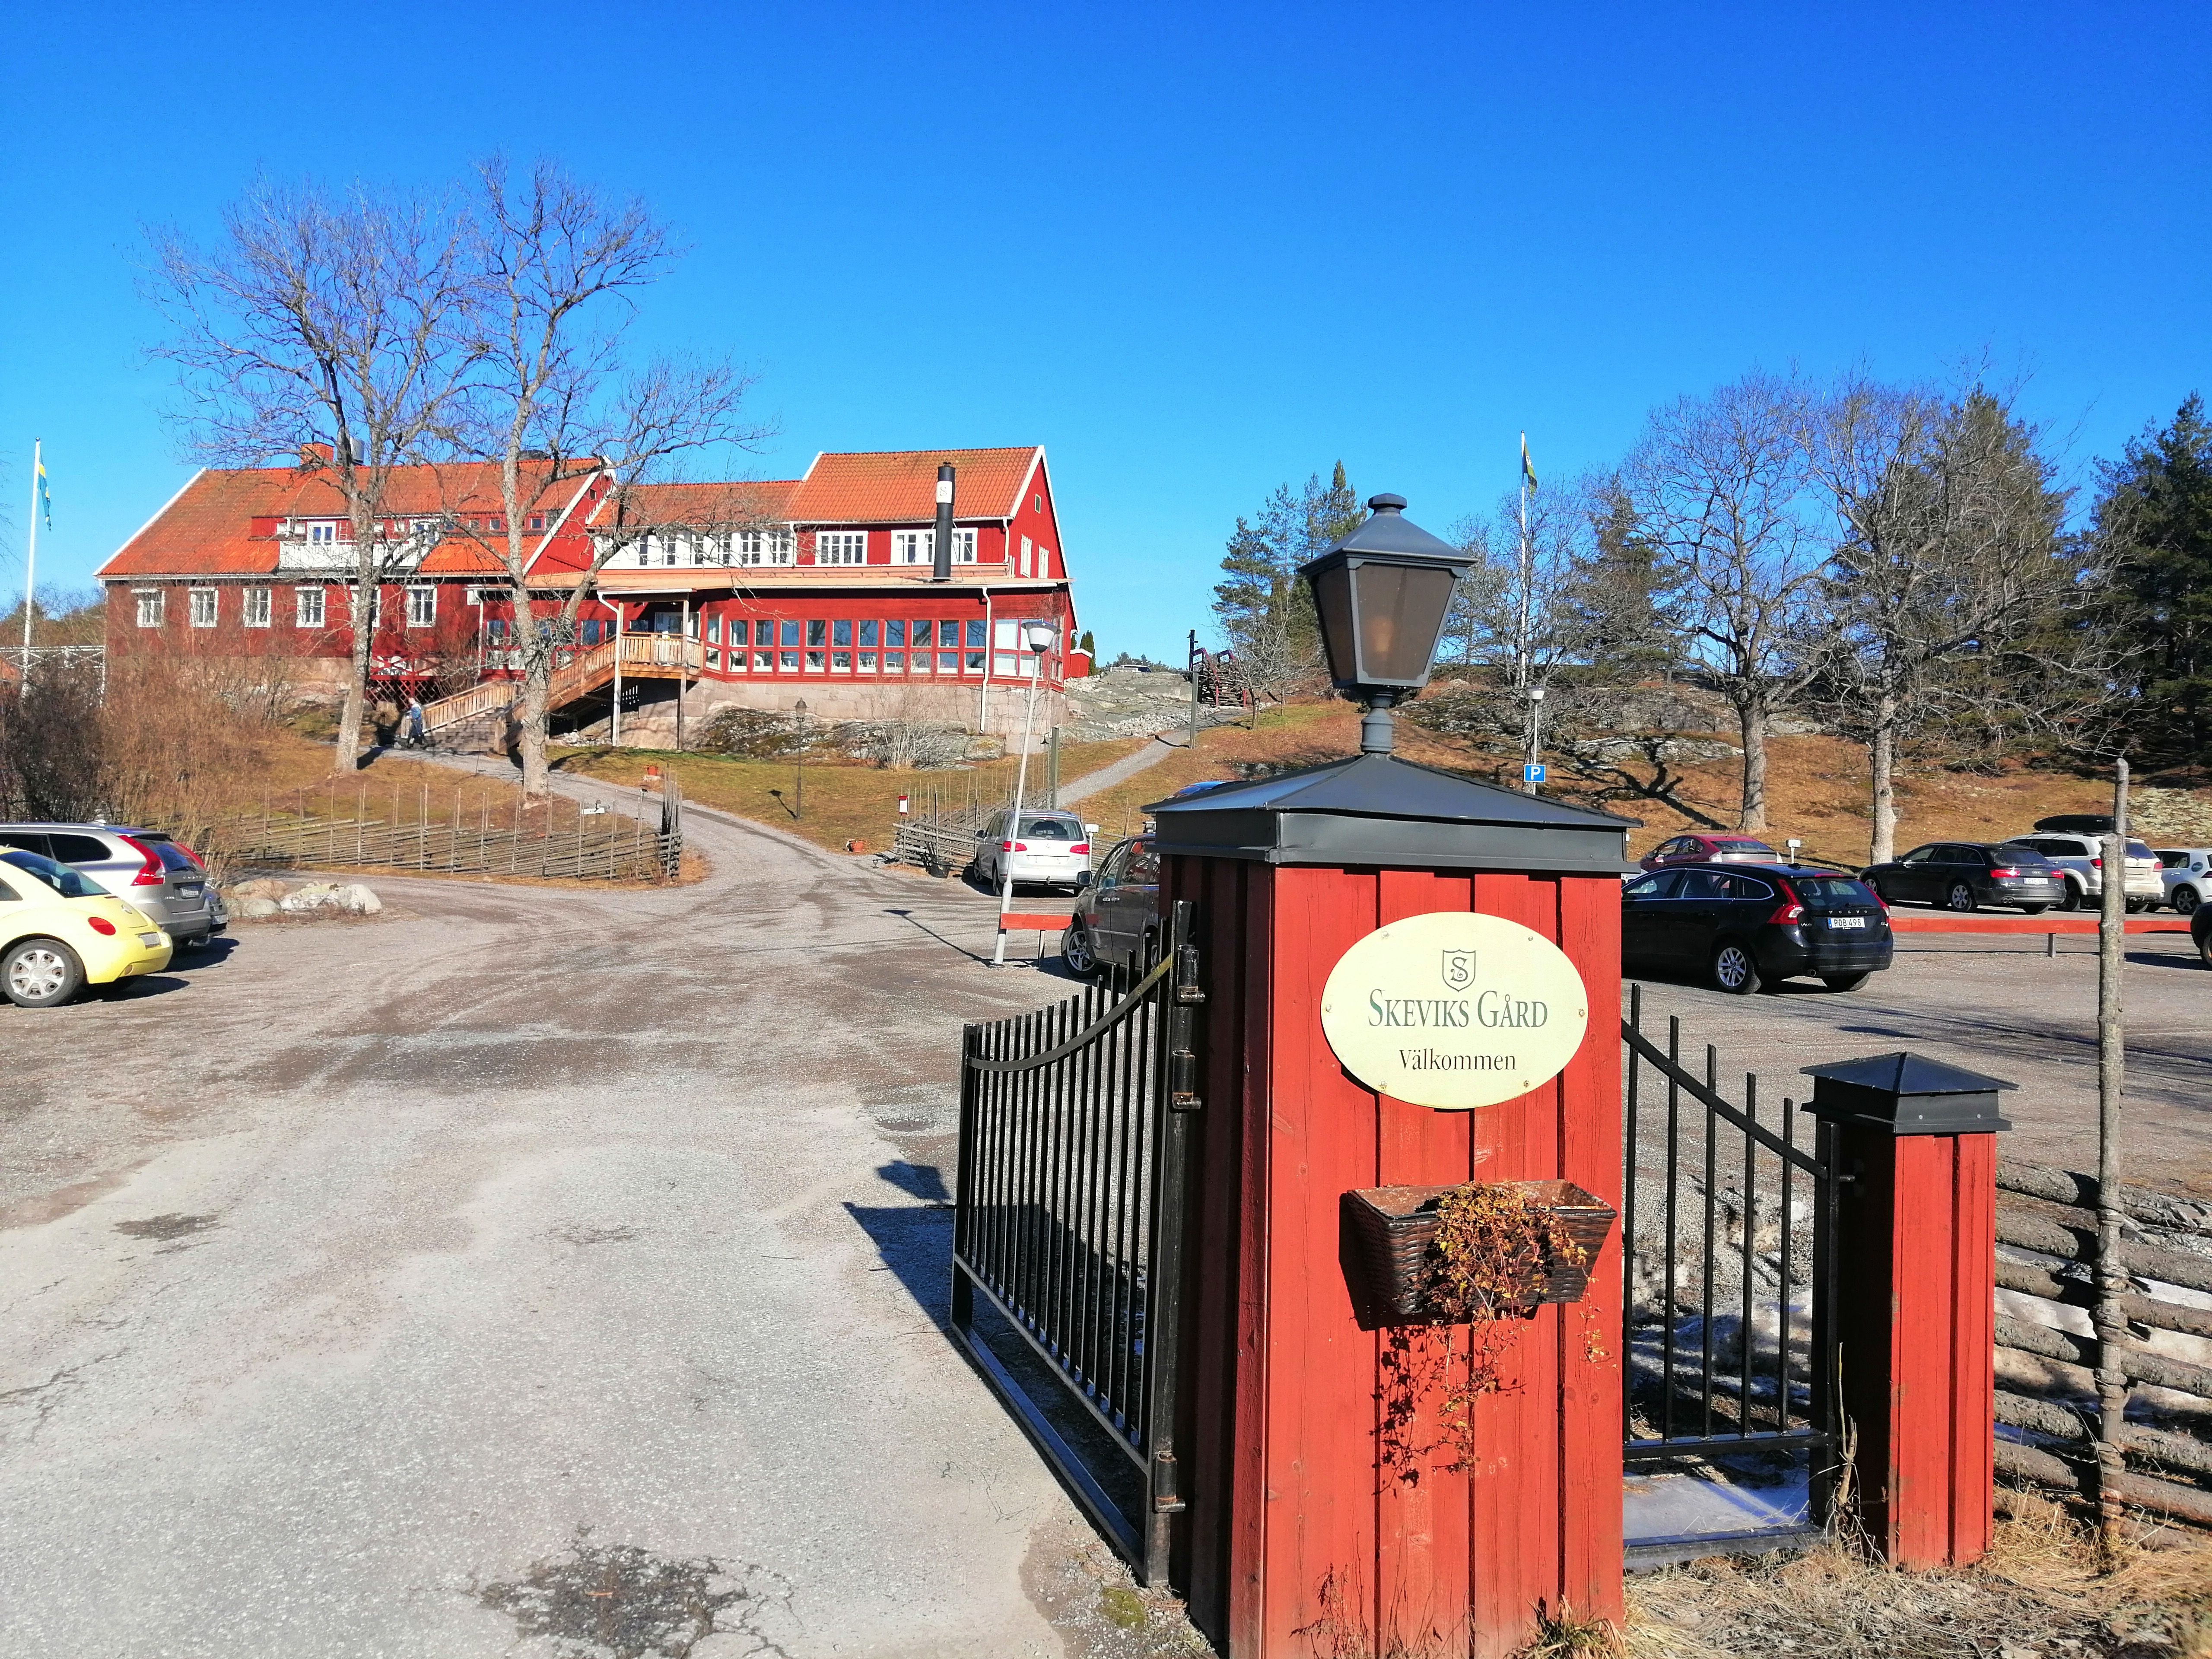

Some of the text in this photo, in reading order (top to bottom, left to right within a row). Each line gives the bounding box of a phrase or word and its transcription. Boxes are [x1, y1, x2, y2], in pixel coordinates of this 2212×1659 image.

[940, 486, 947, 496] S
[1531, 766, 1541, 780] P
[1450, 957, 1468, 982] S
[1368, 988, 1548, 1028] SKEVIKS GÅRD
[1399, 1048, 1516, 1070] Välkommen
